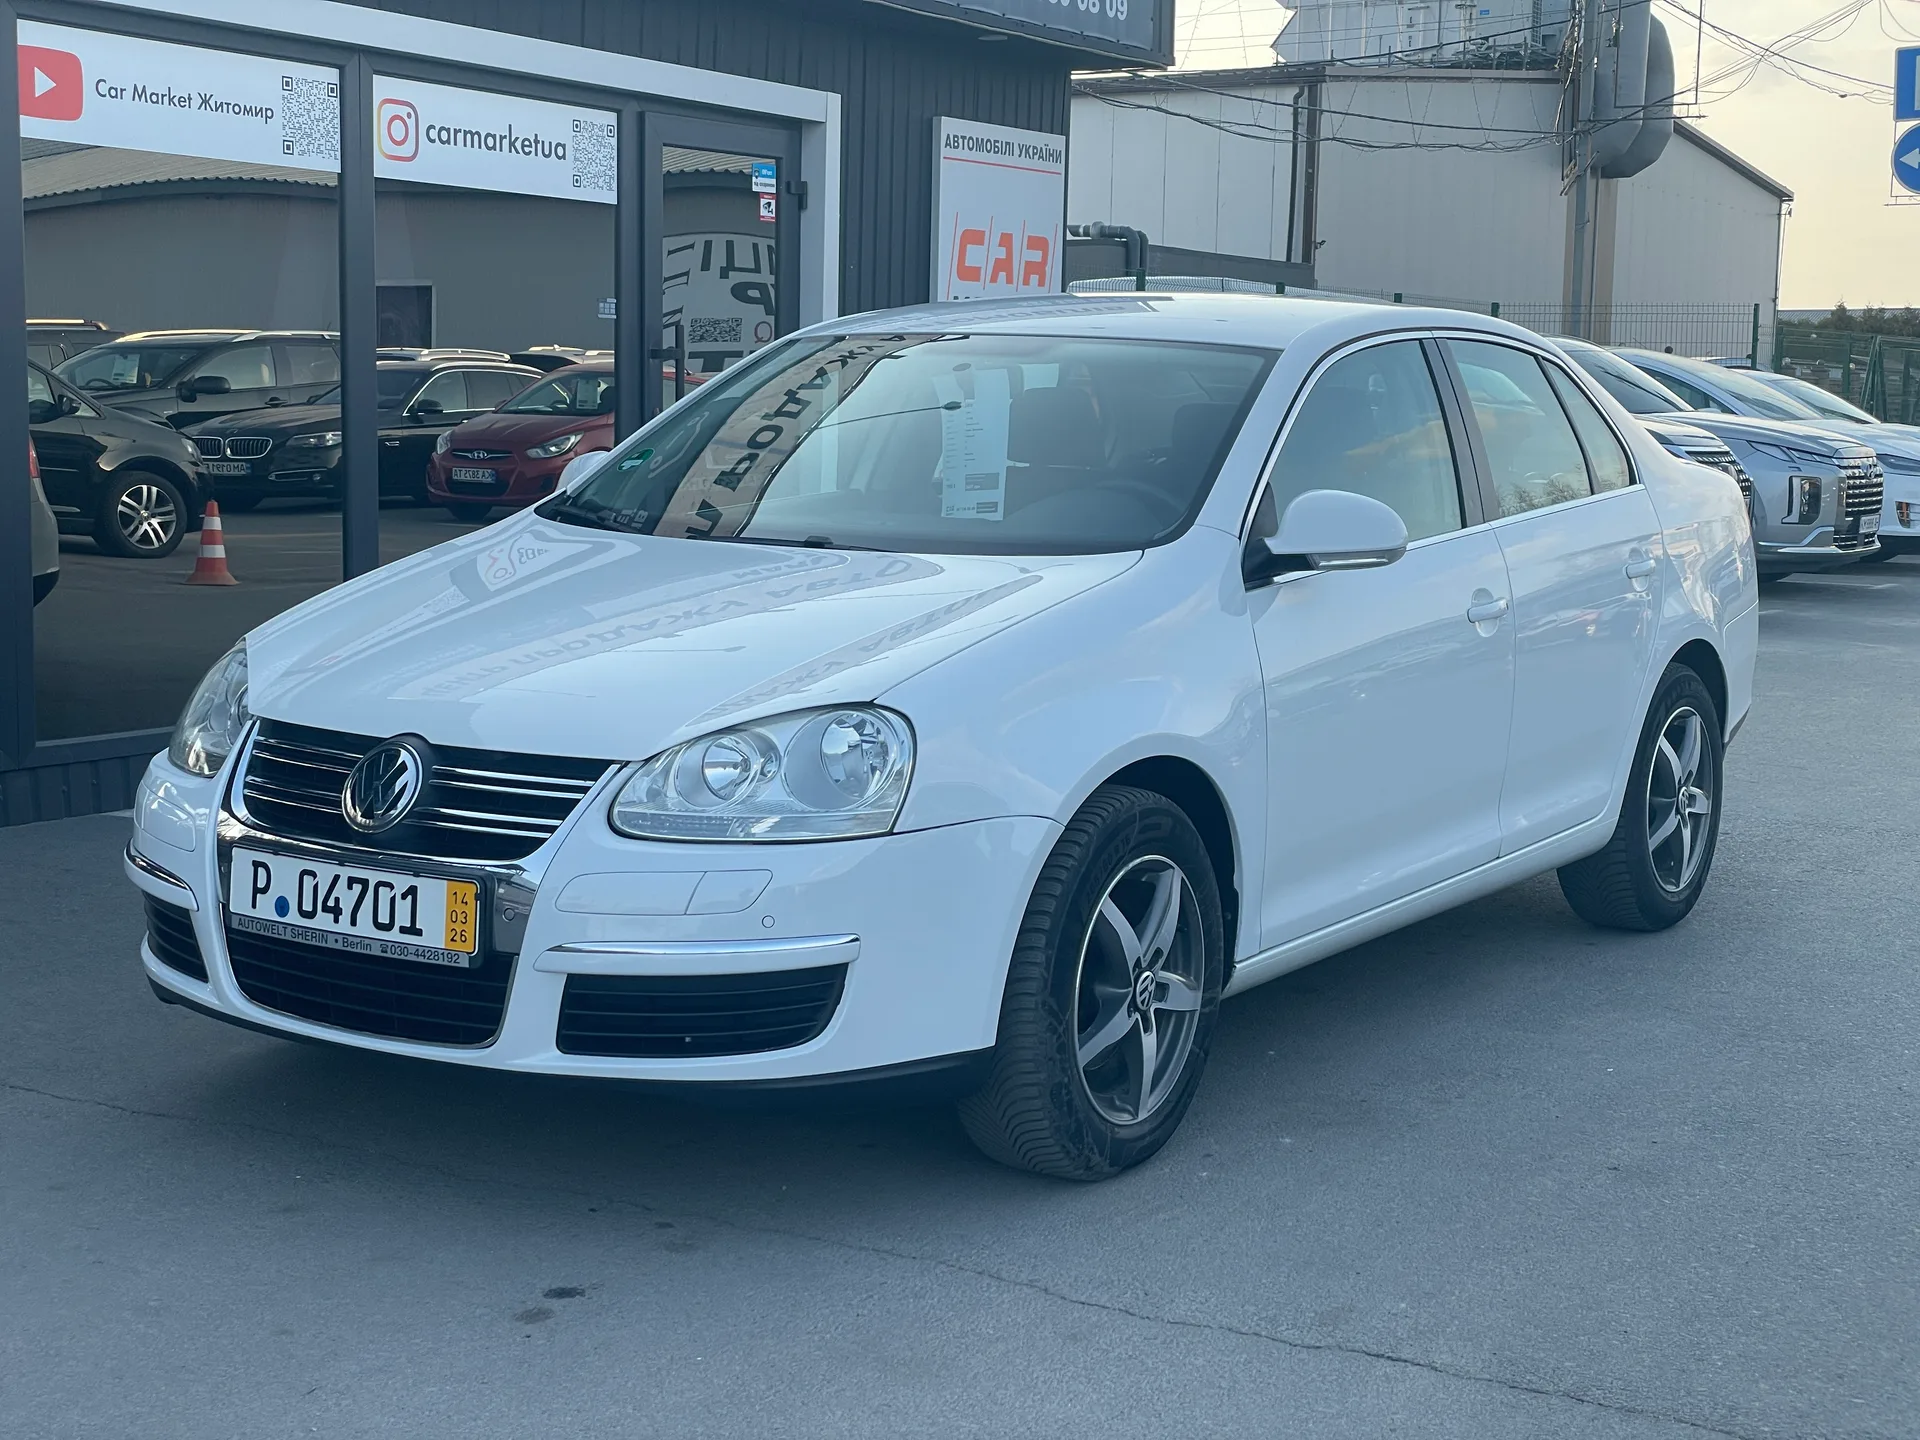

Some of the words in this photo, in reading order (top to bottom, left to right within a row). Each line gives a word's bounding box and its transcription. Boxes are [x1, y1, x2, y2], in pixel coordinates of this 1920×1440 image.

[1106, 0, 1128, 20] 09
[95, 78, 127, 100] Car
[132, 83, 192, 109] Market
[197, 91, 275, 124] Житомир
[425, 123, 567, 161] carmarketua
[944, 133, 1015, 157] АВТОМОБІЛІ
[1017, 143, 1062, 164] УКРАЇНИ
[956, 228, 1050, 288] CAR
[251, 859, 272, 910] P
[297, 868, 424, 938] 04701
[452, 891, 469, 906] 14
[450, 909, 468, 925] 03
[237, 917, 288, 937] AUTOWELT
[290, 925, 329, 945] SHERIN
[342, 938, 372, 952] Berlin
[390, 944, 461, 965] 030-4428192
[450, 927, 468, 944] 26
